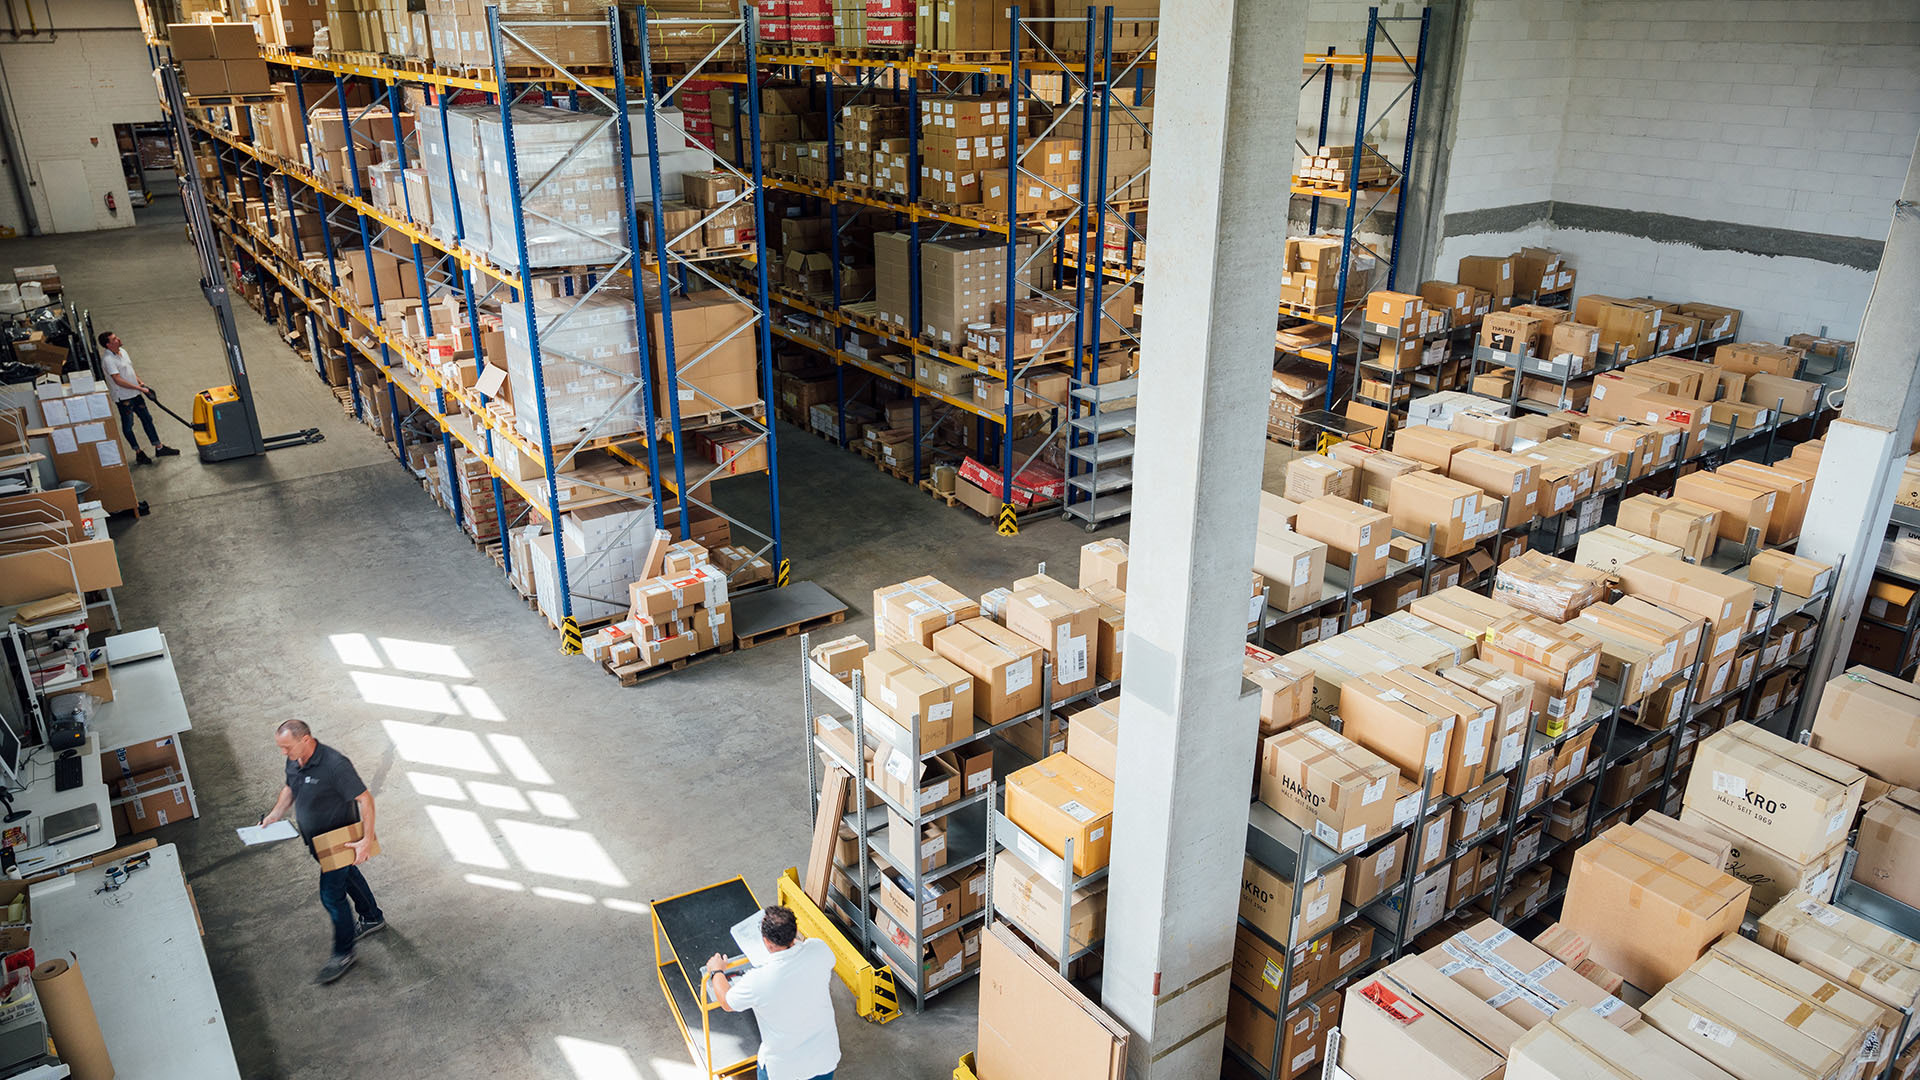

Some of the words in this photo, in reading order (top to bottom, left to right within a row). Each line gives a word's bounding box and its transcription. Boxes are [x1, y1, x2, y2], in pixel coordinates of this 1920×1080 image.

[1282, 774, 1321, 808] HAKRO
[1738, 788, 1778, 815] KRO
[1737, 803, 1753, 816] SEIT
[1754, 812, 1774, 826] 1969
